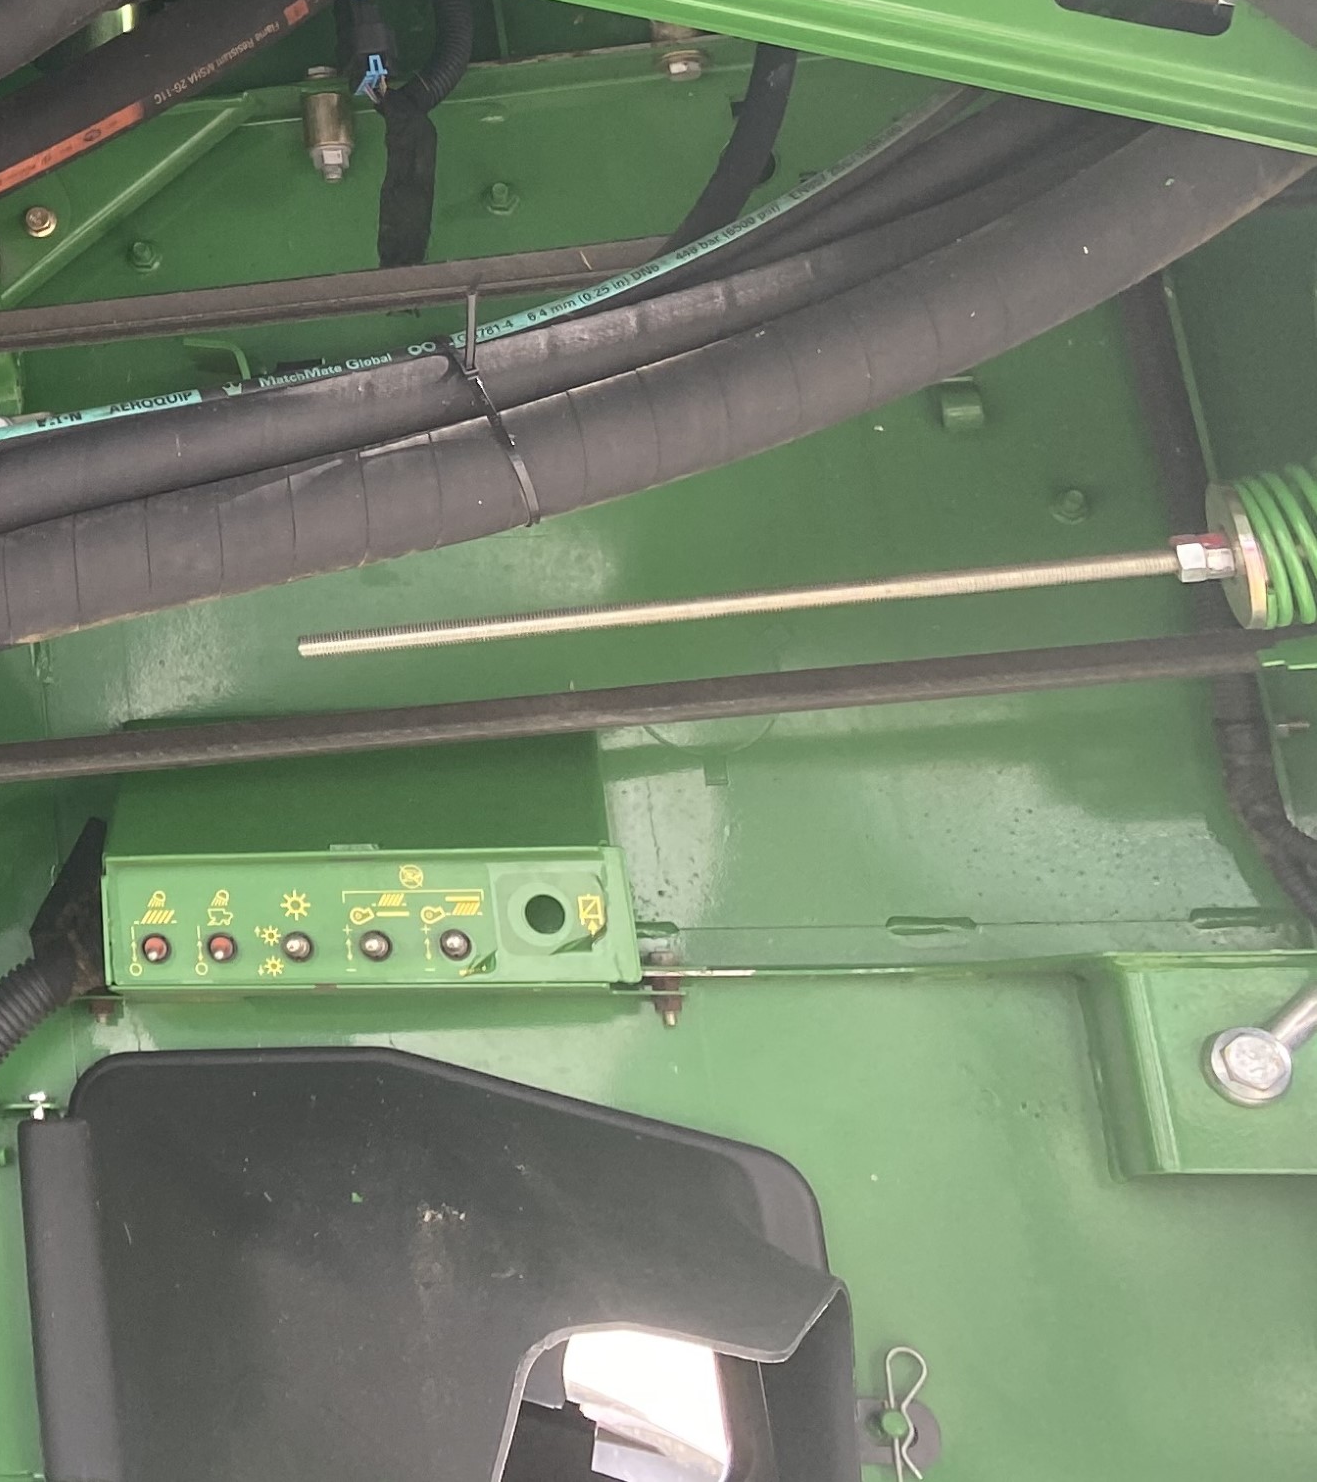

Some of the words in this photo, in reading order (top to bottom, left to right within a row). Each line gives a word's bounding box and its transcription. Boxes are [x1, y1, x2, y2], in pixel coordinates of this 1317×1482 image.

[252, 19, 281, 42] Flame
[213, 36, 255, 67] Resistant
[185, 60, 216, 84] MSHA
[258, 362, 342, 388] MatchMate
[345, 352, 392, 371] Global
[549, 298, 577, 314] mm
[698, 233, 720, 250] bar
